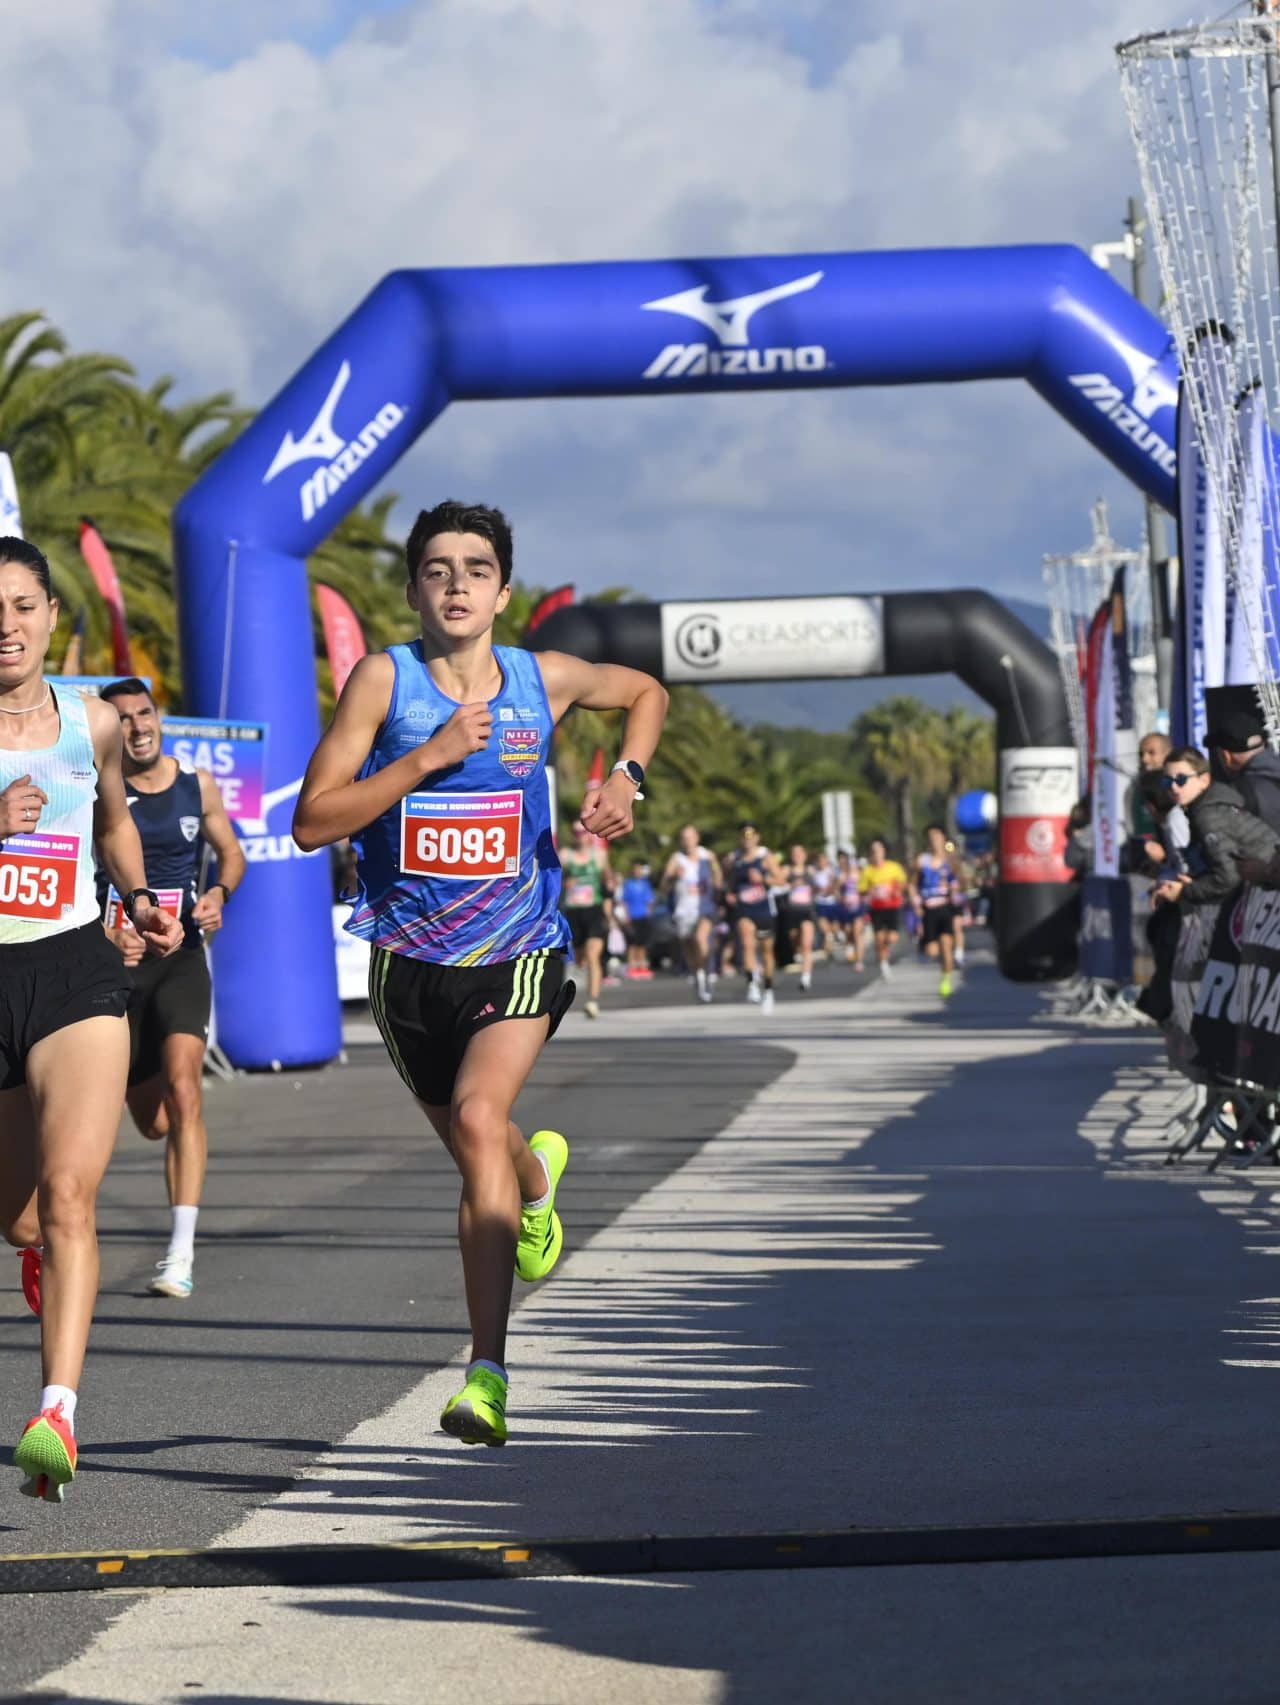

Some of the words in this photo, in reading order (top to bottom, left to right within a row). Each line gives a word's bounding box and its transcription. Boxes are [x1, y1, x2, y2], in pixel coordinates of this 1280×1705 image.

[642, 344, 827, 379] MIZUNO
[300, 402, 405, 522] MIZUNO
[729, 621, 876, 646] CREASPORTS
[507, 731, 537, 740] NICE
[173, 740, 235, 776] SAS
[416, 827, 506, 864] 6093
